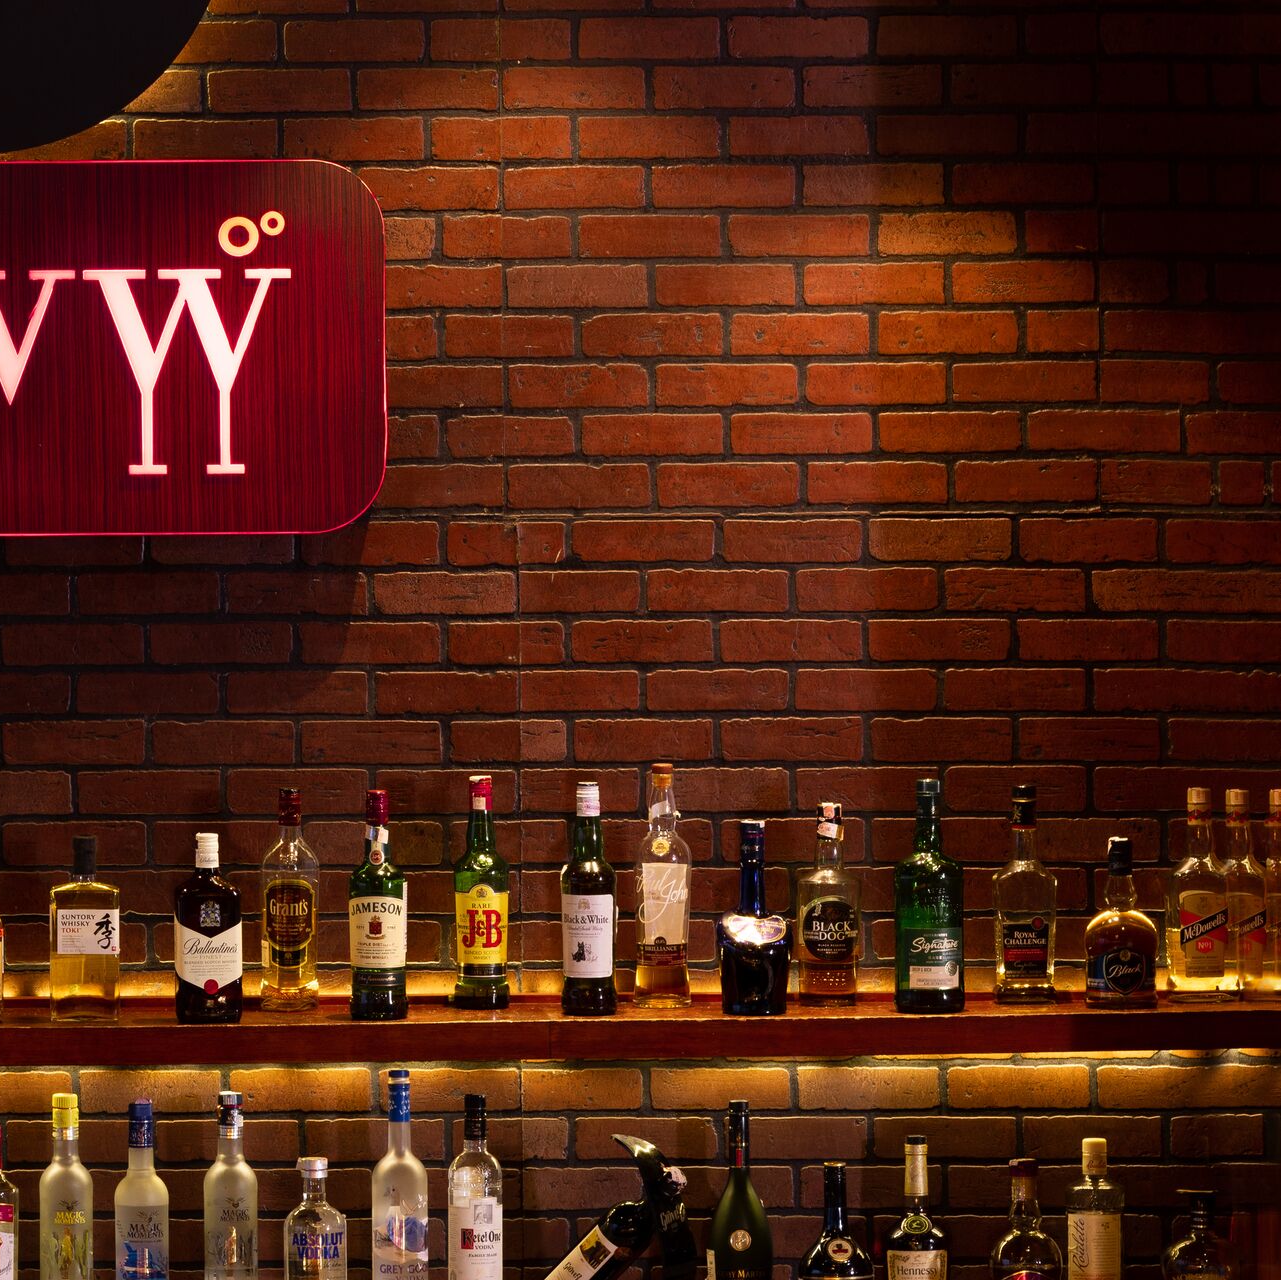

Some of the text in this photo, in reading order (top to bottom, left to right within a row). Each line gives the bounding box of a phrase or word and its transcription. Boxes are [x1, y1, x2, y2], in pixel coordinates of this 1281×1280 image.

[269, 898, 309, 917] Grant's
[351, 902, 403, 916] JAMESON
[462, 909, 503, 948] J&B
[812, 920, 852, 932] BLACK
[1182, 913, 1227, 943] McDowell's
[818, 931, 846, 942] DOG
[1004, 937, 1047, 946] CHALLENGE
[1013, 930, 1037, 939] ROYAL
[183, 937, 238, 955] Ballantine's
[910, 936, 959, 954] Signature
[1106, 962, 1142, 979] Black
[55, 1211, 85, 1219] MAGIC
[292, 1231, 344, 1247] ABSOLUT
[461, 1228, 501, 1249] Ketel One
[297, 1246, 340, 1259] VODKA
[379, 1263, 404, 1275] GREY
[896, 1265, 938, 1277] Hennessy
